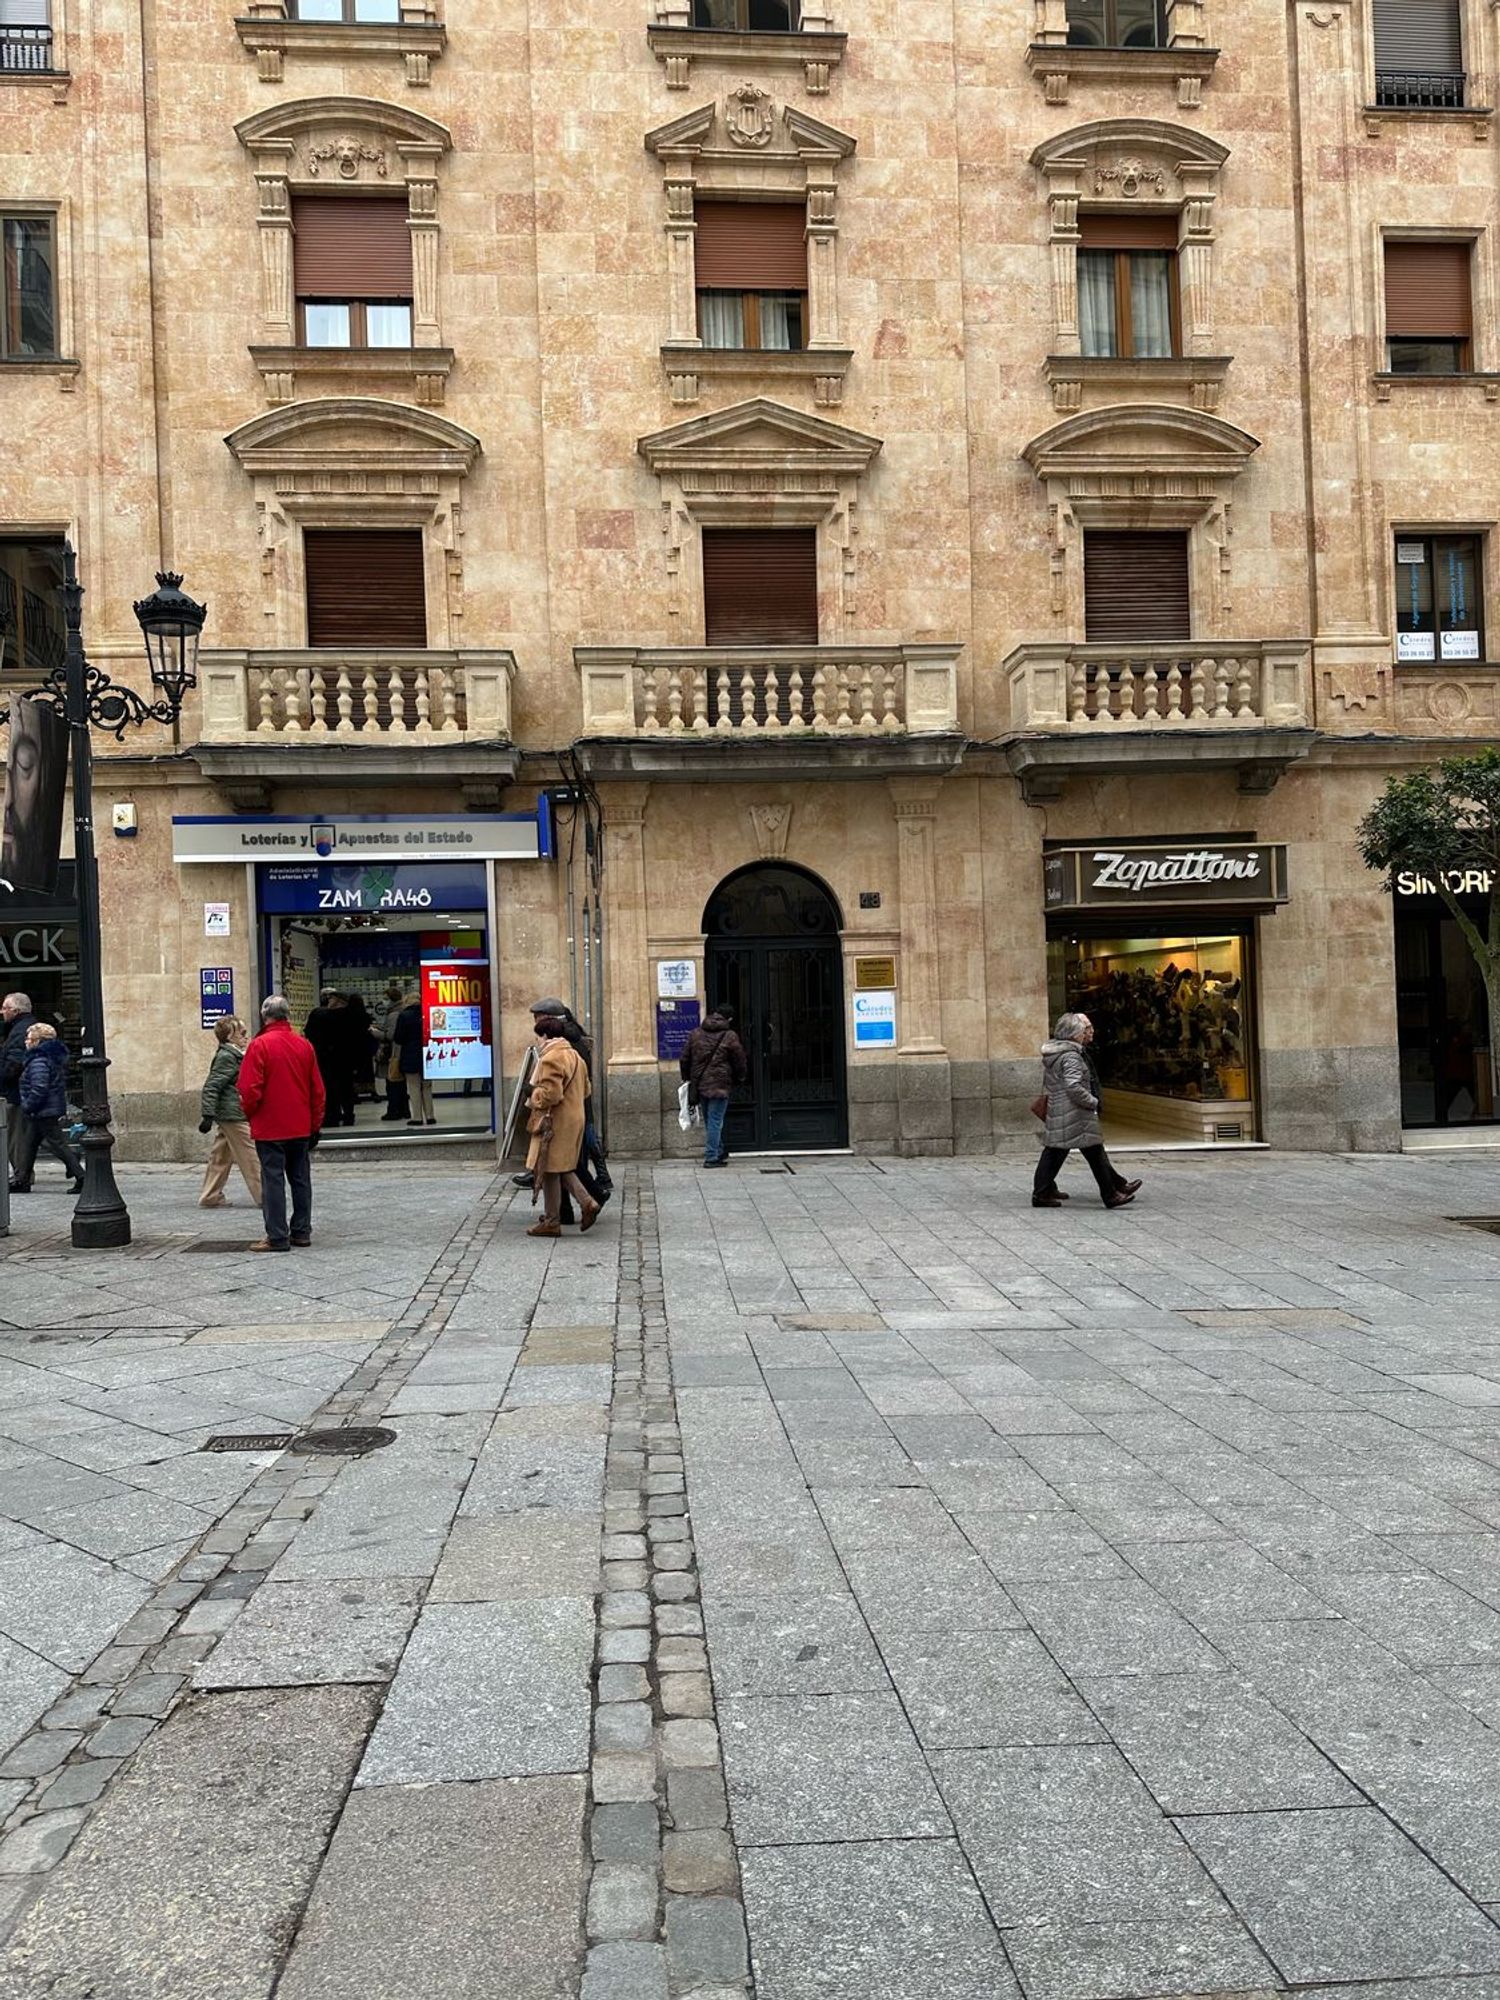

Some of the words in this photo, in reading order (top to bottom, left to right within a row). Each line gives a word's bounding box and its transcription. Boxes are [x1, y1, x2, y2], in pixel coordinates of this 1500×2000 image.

[241, 832, 296, 845] Loterías
[300, 835, 308, 847] y
[339, 832, 399, 847] Apuestas
[404, 831, 424, 844] del
[428, 830, 473, 844] Estado
[1092, 851, 1261, 891] Zapattoni
[862, 893, 879, 907] 48
